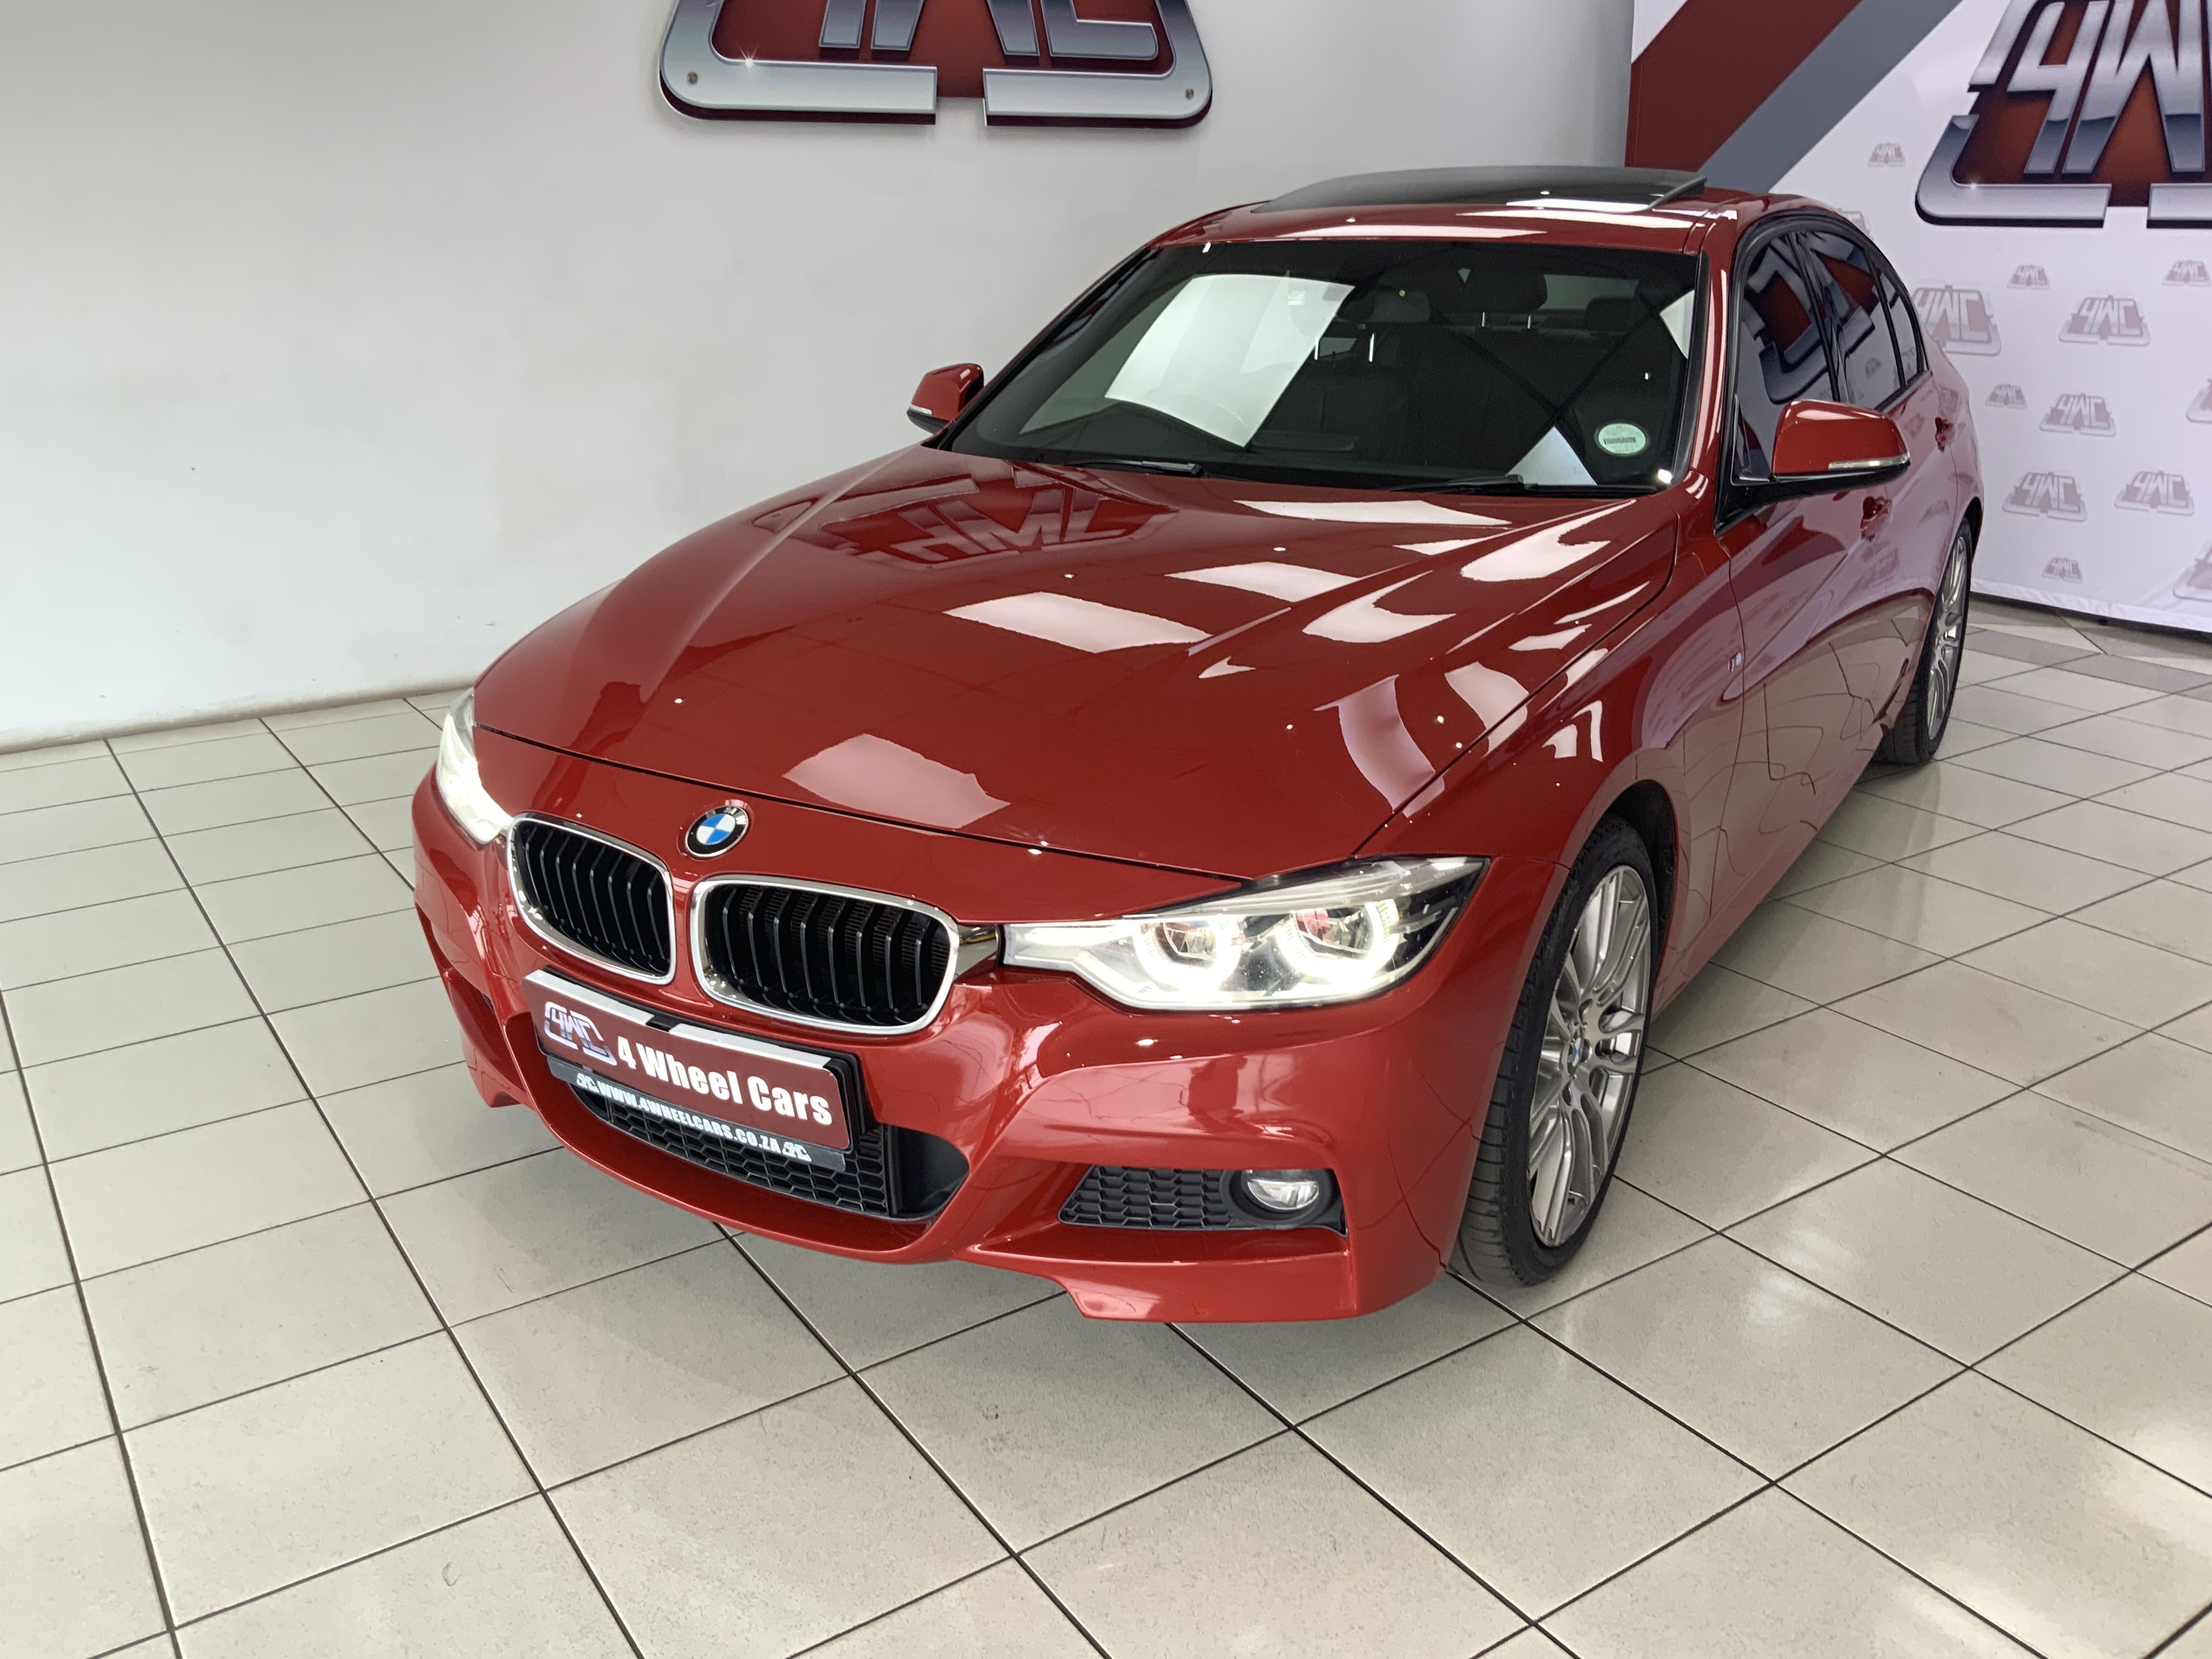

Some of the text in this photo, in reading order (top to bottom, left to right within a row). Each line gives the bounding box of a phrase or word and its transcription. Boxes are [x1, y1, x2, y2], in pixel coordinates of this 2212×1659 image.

[2006, 1, 2212, 173] 4W
[596, 1080, 782, 1153] WWW.4WHEELCARS.CO.ZA
[618, 1036, 637, 1070] 4
[635, 1042, 743, 1105] Wheel
[747, 1076, 833, 1125] Cars
